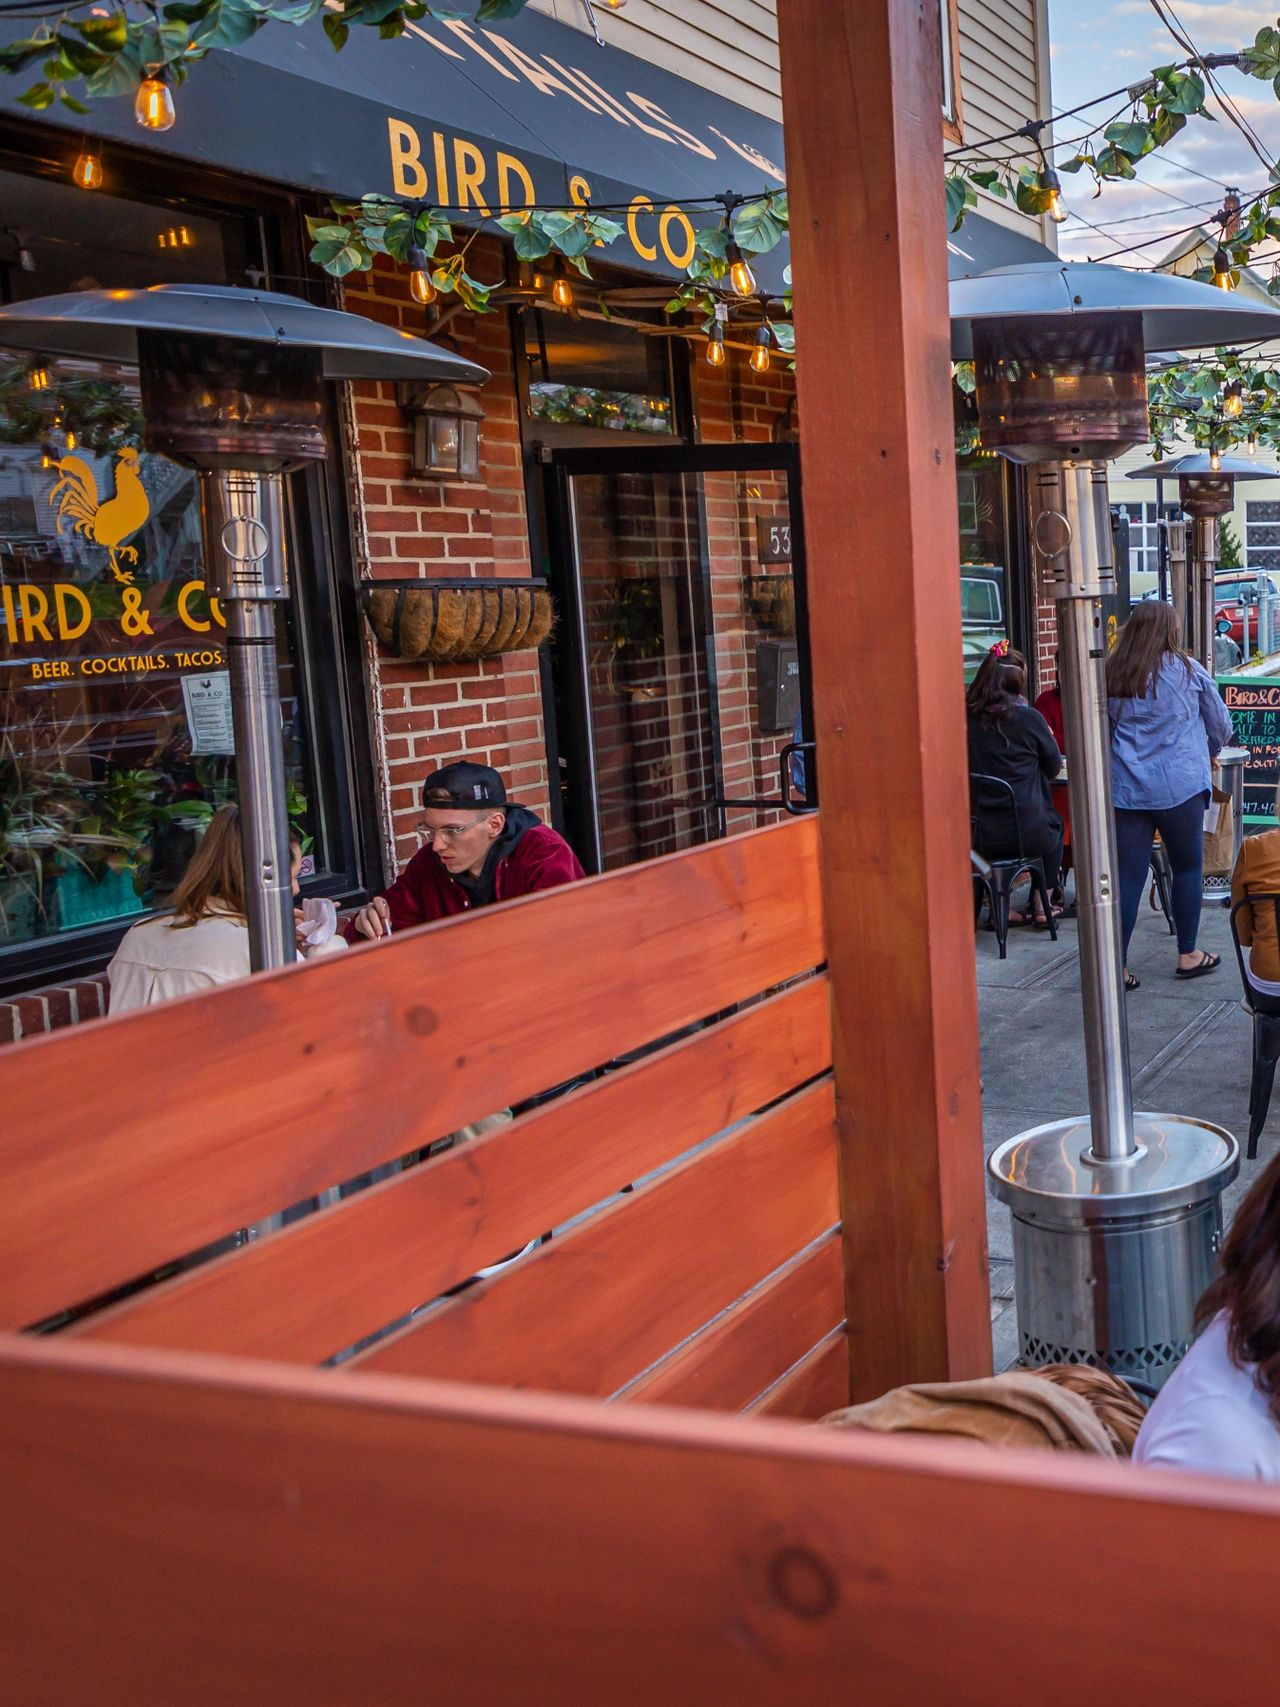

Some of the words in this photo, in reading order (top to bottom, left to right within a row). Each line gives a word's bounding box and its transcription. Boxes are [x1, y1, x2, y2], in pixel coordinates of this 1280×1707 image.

[398, 0, 717, 160] TAILS
[388, 117, 535, 224] BIRD
[627, 195, 696, 269] CO
[1, 583, 92, 643] IRD
[120, 586, 155, 637] &
[178, 580, 227, 632] C
[32, 662, 76, 679] BEER.
[81, 655, 170, 675] COCKTAILS.
[175, 650, 226, 668] TACOS.
[1233, 724, 1255, 735] AIT
[1261, 724, 1276, 735] TO
[1264, 711, 1276, 724] IN
[1252, 745, 1263, 754] IN
